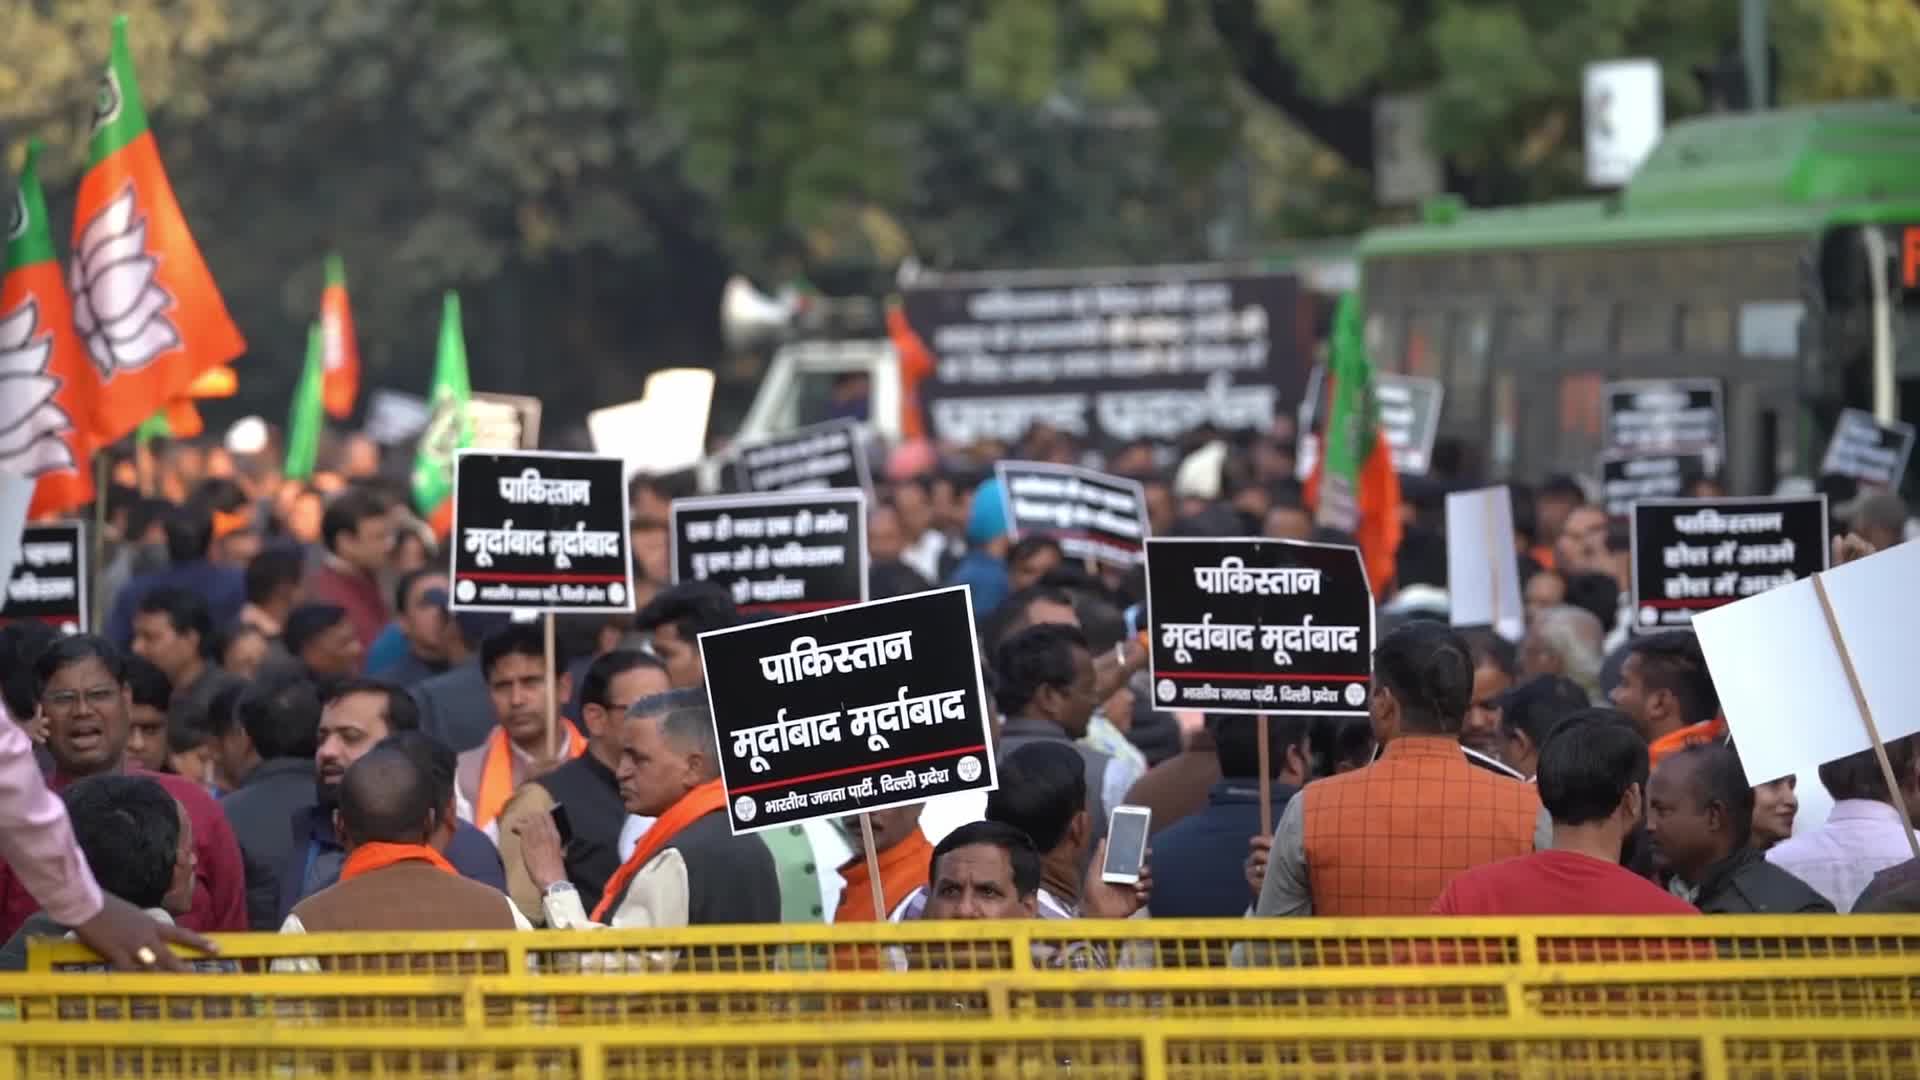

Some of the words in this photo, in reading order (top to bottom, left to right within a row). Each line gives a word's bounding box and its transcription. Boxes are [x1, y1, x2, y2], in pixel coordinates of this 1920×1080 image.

[499, 468, 590, 505] पाकिस्तान
[1673, 509, 1782, 534] पाकिस्तान
[465, 519, 544, 567] मूर्दाबाद
[1663, 541, 1709, 567] होश
[1712, 539, 1737, 564] में
[1194, 556, 1321, 595] पाकिस्तान
[1664, 572, 1710, 598] होश
[1713, 571, 1738, 595] में
[760, 630, 913, 685] पाकिस्तान
[1161, 613, 1254, 664] मूर्दाबाद
[1260, 614, 1359, 665] मूर्दाबाद
[1183, 683, 1219, 701] भारतीय
[1222, 687, 1251, 701] जनता
[1280, 685, 1311, 702] दिल्ली
[1313, 687, 1338, 704] प्रदेश
[730, 708, 842, 773] मूर्दाबाद
[847, 687, 966, 751] मूर्दाबाद
[765, 791, 808, 814] भारतीय
[811, 785, 846, 805] जनता
[848, 777, 878, 800] पार्टी,
[880, 769, 917, 793] दिल्ली
[919, 768, 950, 789] प्रदेश
